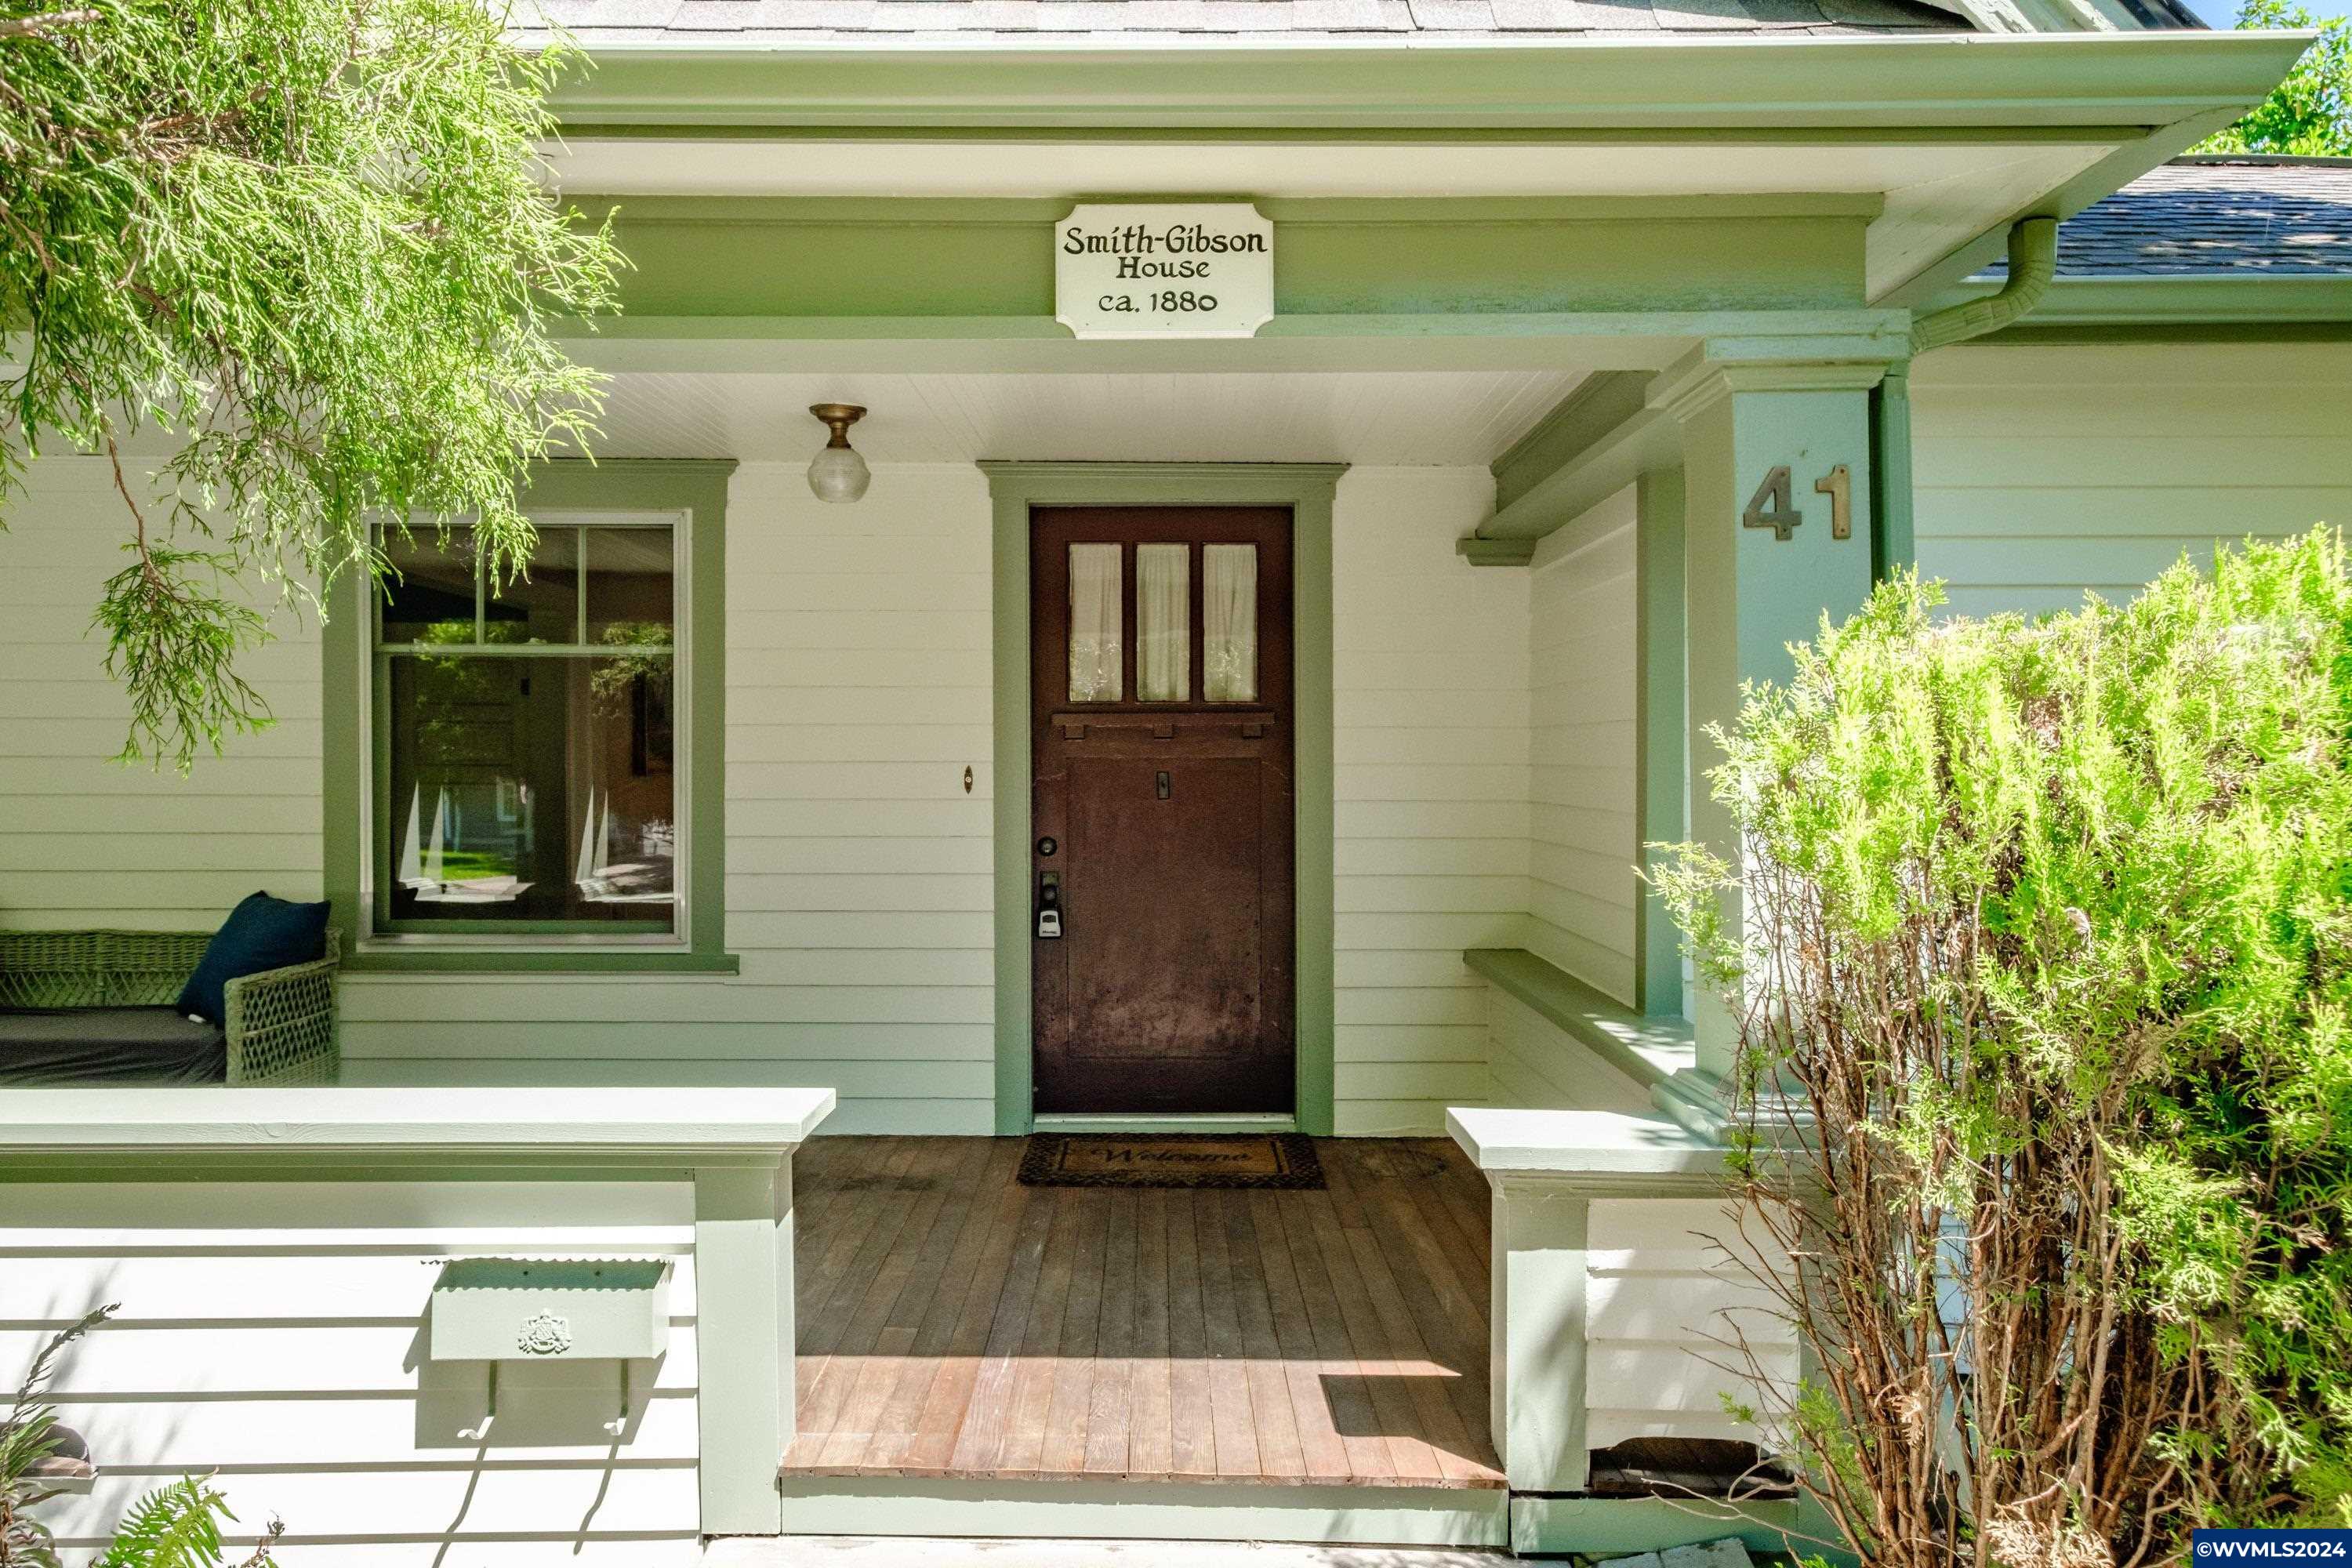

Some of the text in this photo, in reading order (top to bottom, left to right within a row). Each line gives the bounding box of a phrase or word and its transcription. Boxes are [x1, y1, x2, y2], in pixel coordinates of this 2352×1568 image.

[1063, 224, 1269, 255] Smith-Gibson
[1116, 256, 1211, 278] House
[1098, 290, 1218, 313] ca. 1880
[1743, 464, 1851, 540] 41
[1091, 1147, 1252, 1164] Welcome
